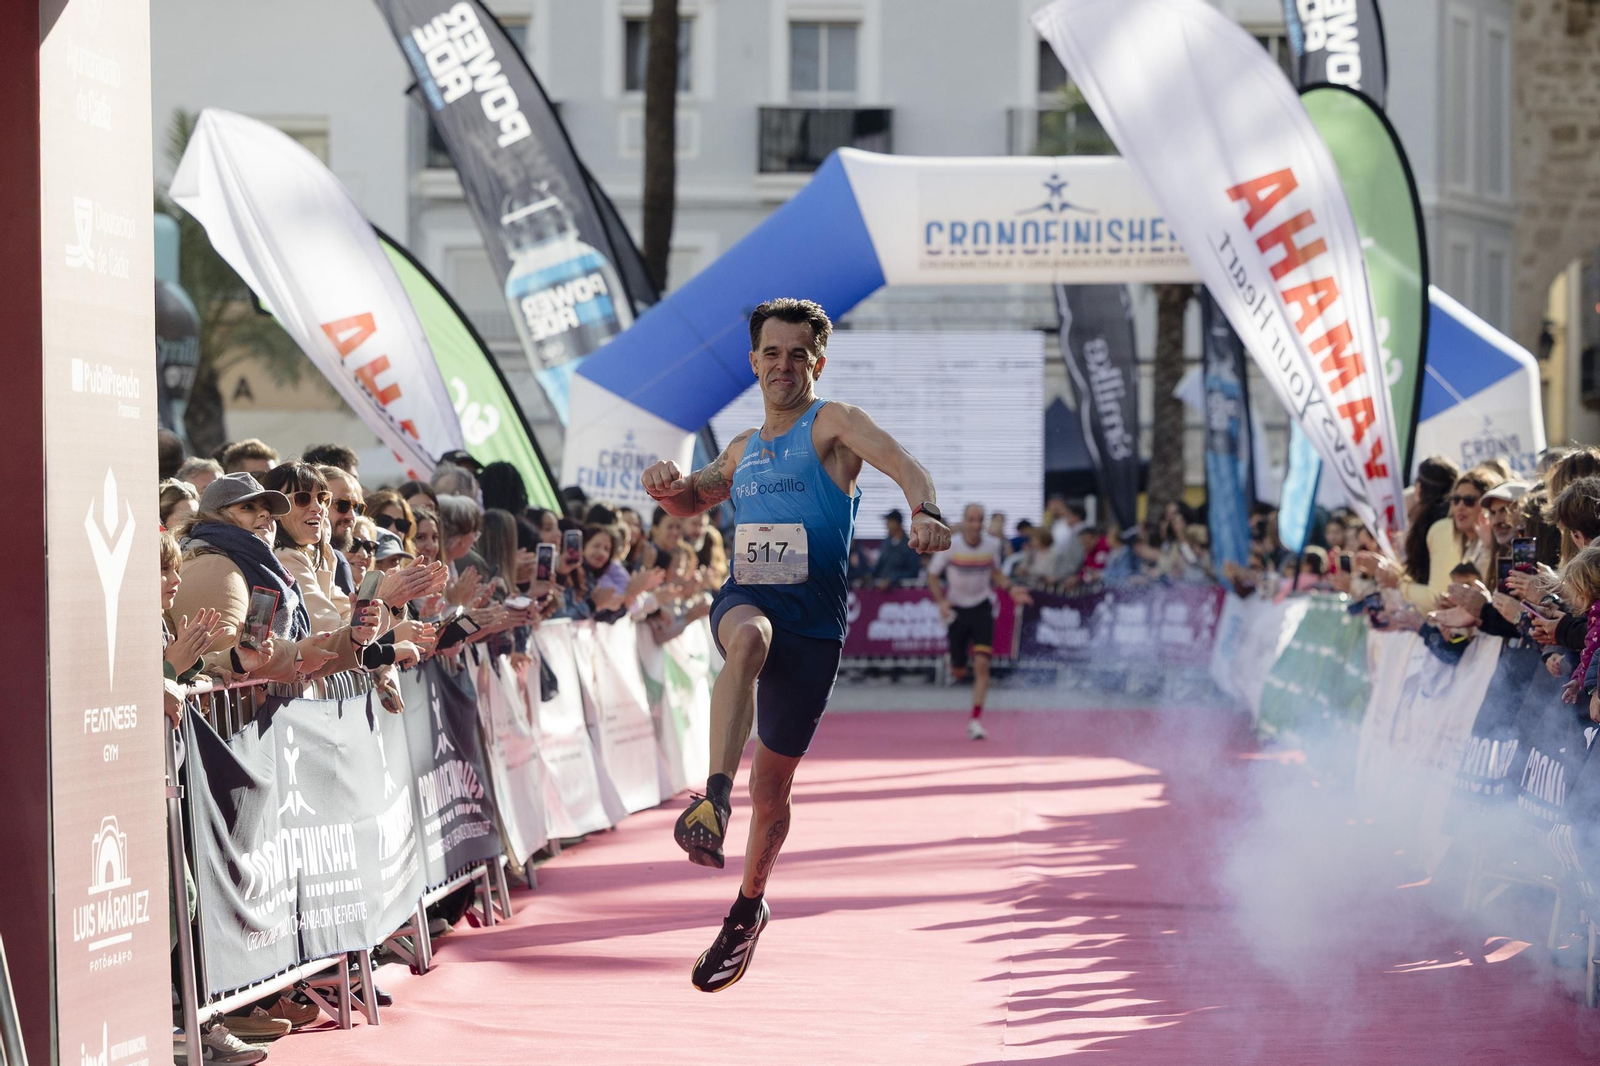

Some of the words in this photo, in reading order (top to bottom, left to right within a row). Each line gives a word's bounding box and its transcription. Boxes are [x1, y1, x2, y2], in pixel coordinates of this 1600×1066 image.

[95, 201, 136, 239] Diputación
[925, 219, 1185, 256] CRONOFINISHE
[97, 245, 108, 275] de
[108, 247, 130, 280] Cádiz
[84, 361, 140, 400] PubliPrenda
[747, 541, 789, 564] 517
[84, 704, 138, 734] FEATNESS
[103, 744, 119, 762] GYM
[73, 902, 95, 942] LUIS
[97, 890, 151, 935] MÁRQUEZ
[89, 951, 132, 974] FOTÓGRAFO
